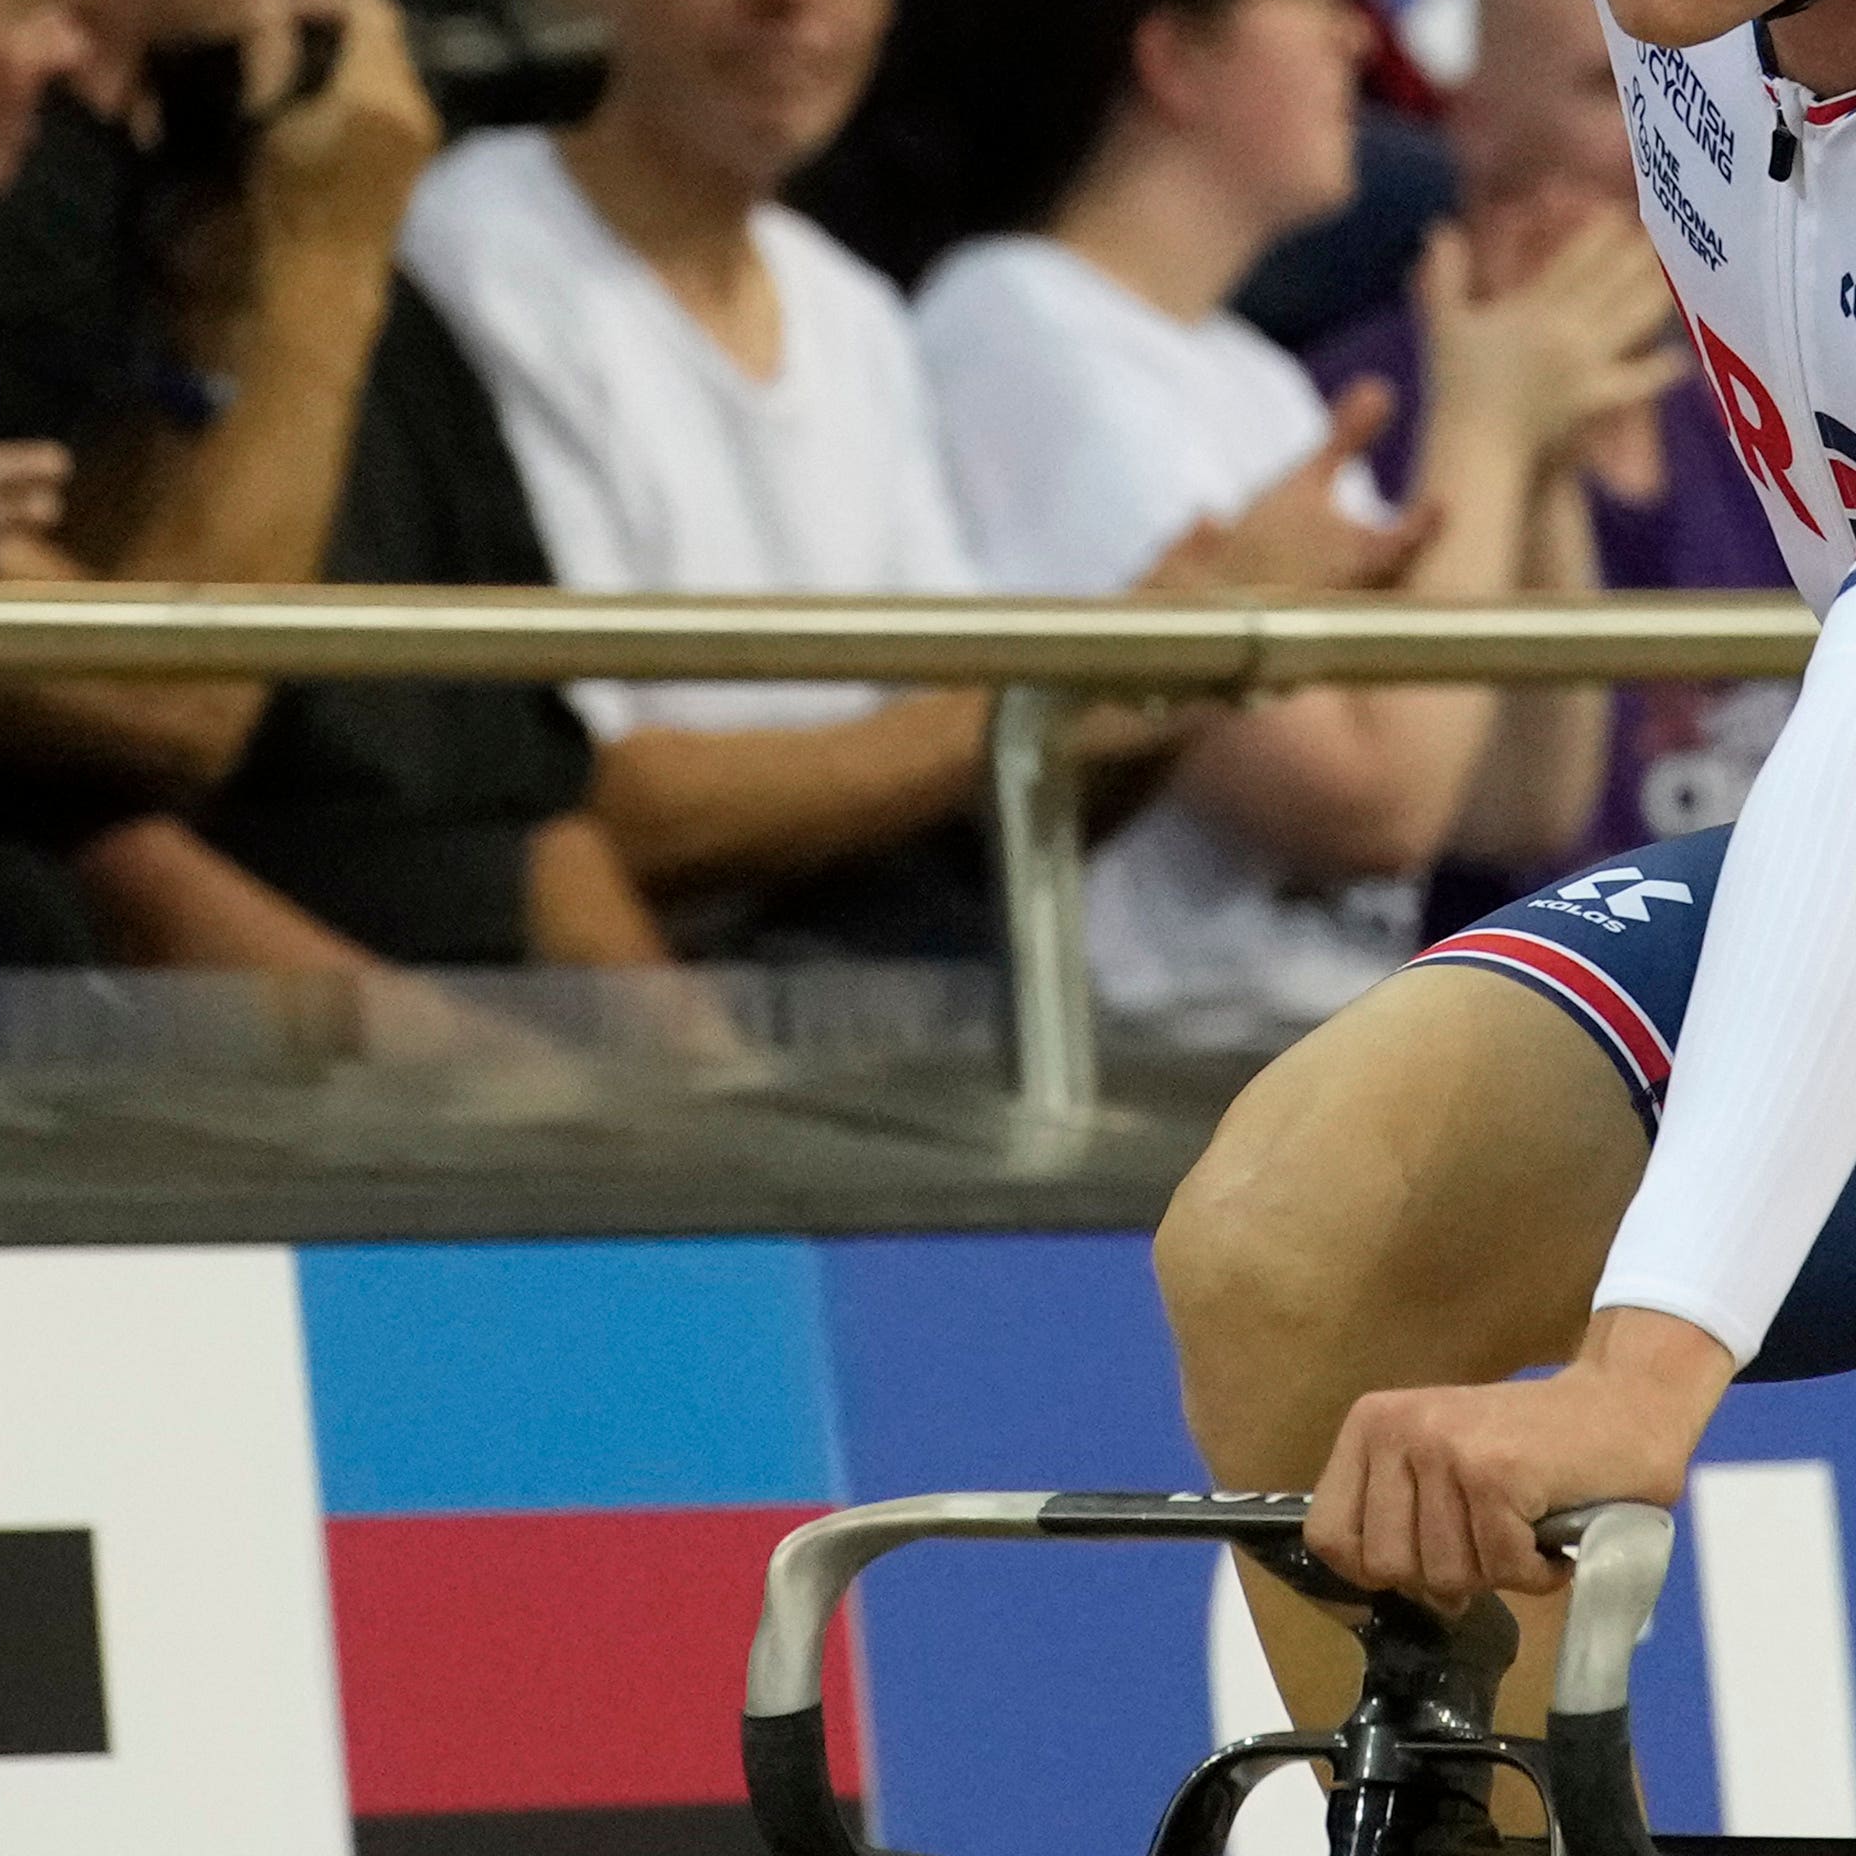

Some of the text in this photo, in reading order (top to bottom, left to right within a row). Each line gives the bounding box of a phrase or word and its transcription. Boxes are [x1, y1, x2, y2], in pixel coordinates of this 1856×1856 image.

[1648, 48, 1734, 185] CYCLING
[1653, 125, 1681, 182] THE
[1655, 43, 1734, 158] RITISH
[1652, 151, 1728, 265] NATIONAL
[1652, 172, 1723, 272] LOTTERY
